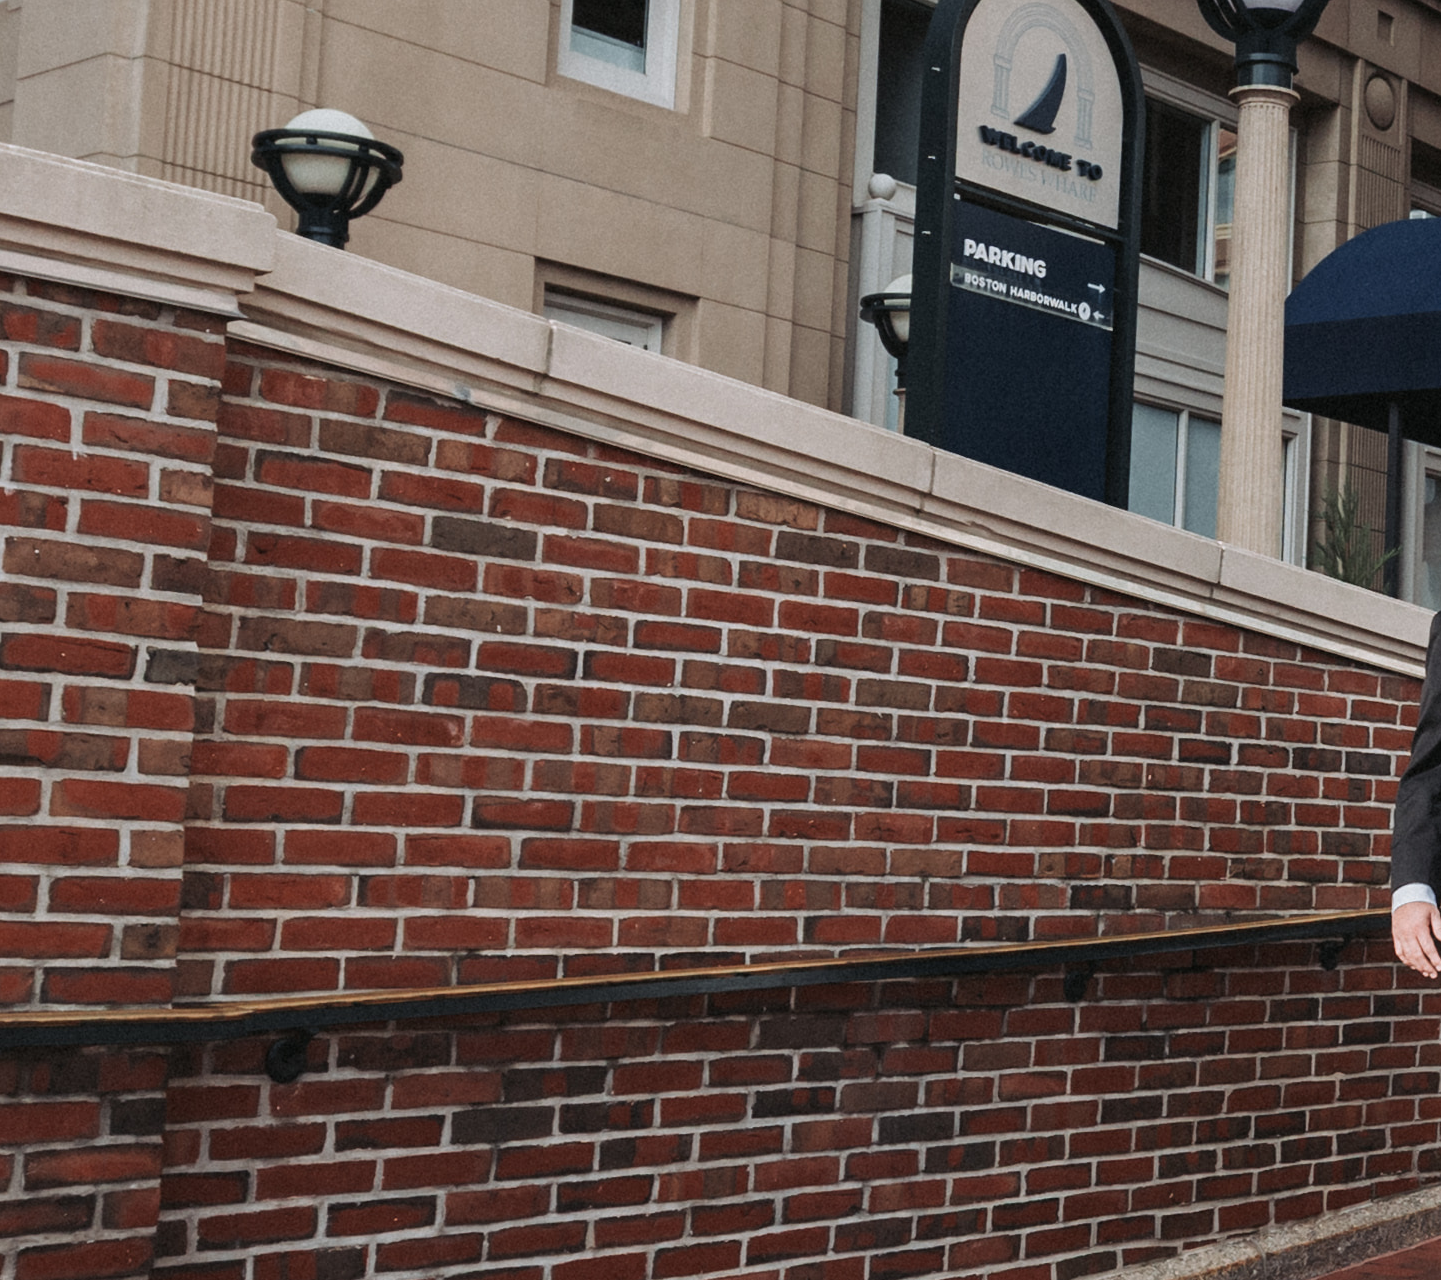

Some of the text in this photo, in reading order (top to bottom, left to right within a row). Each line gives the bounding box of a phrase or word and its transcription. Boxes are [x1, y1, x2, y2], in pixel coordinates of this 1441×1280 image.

[979, 125, 1103, 181] WELCOME TO
[963, 238, 1047, 278] PARKING
[964, 272, 1078, 314] BOSTON HARBORWALK
